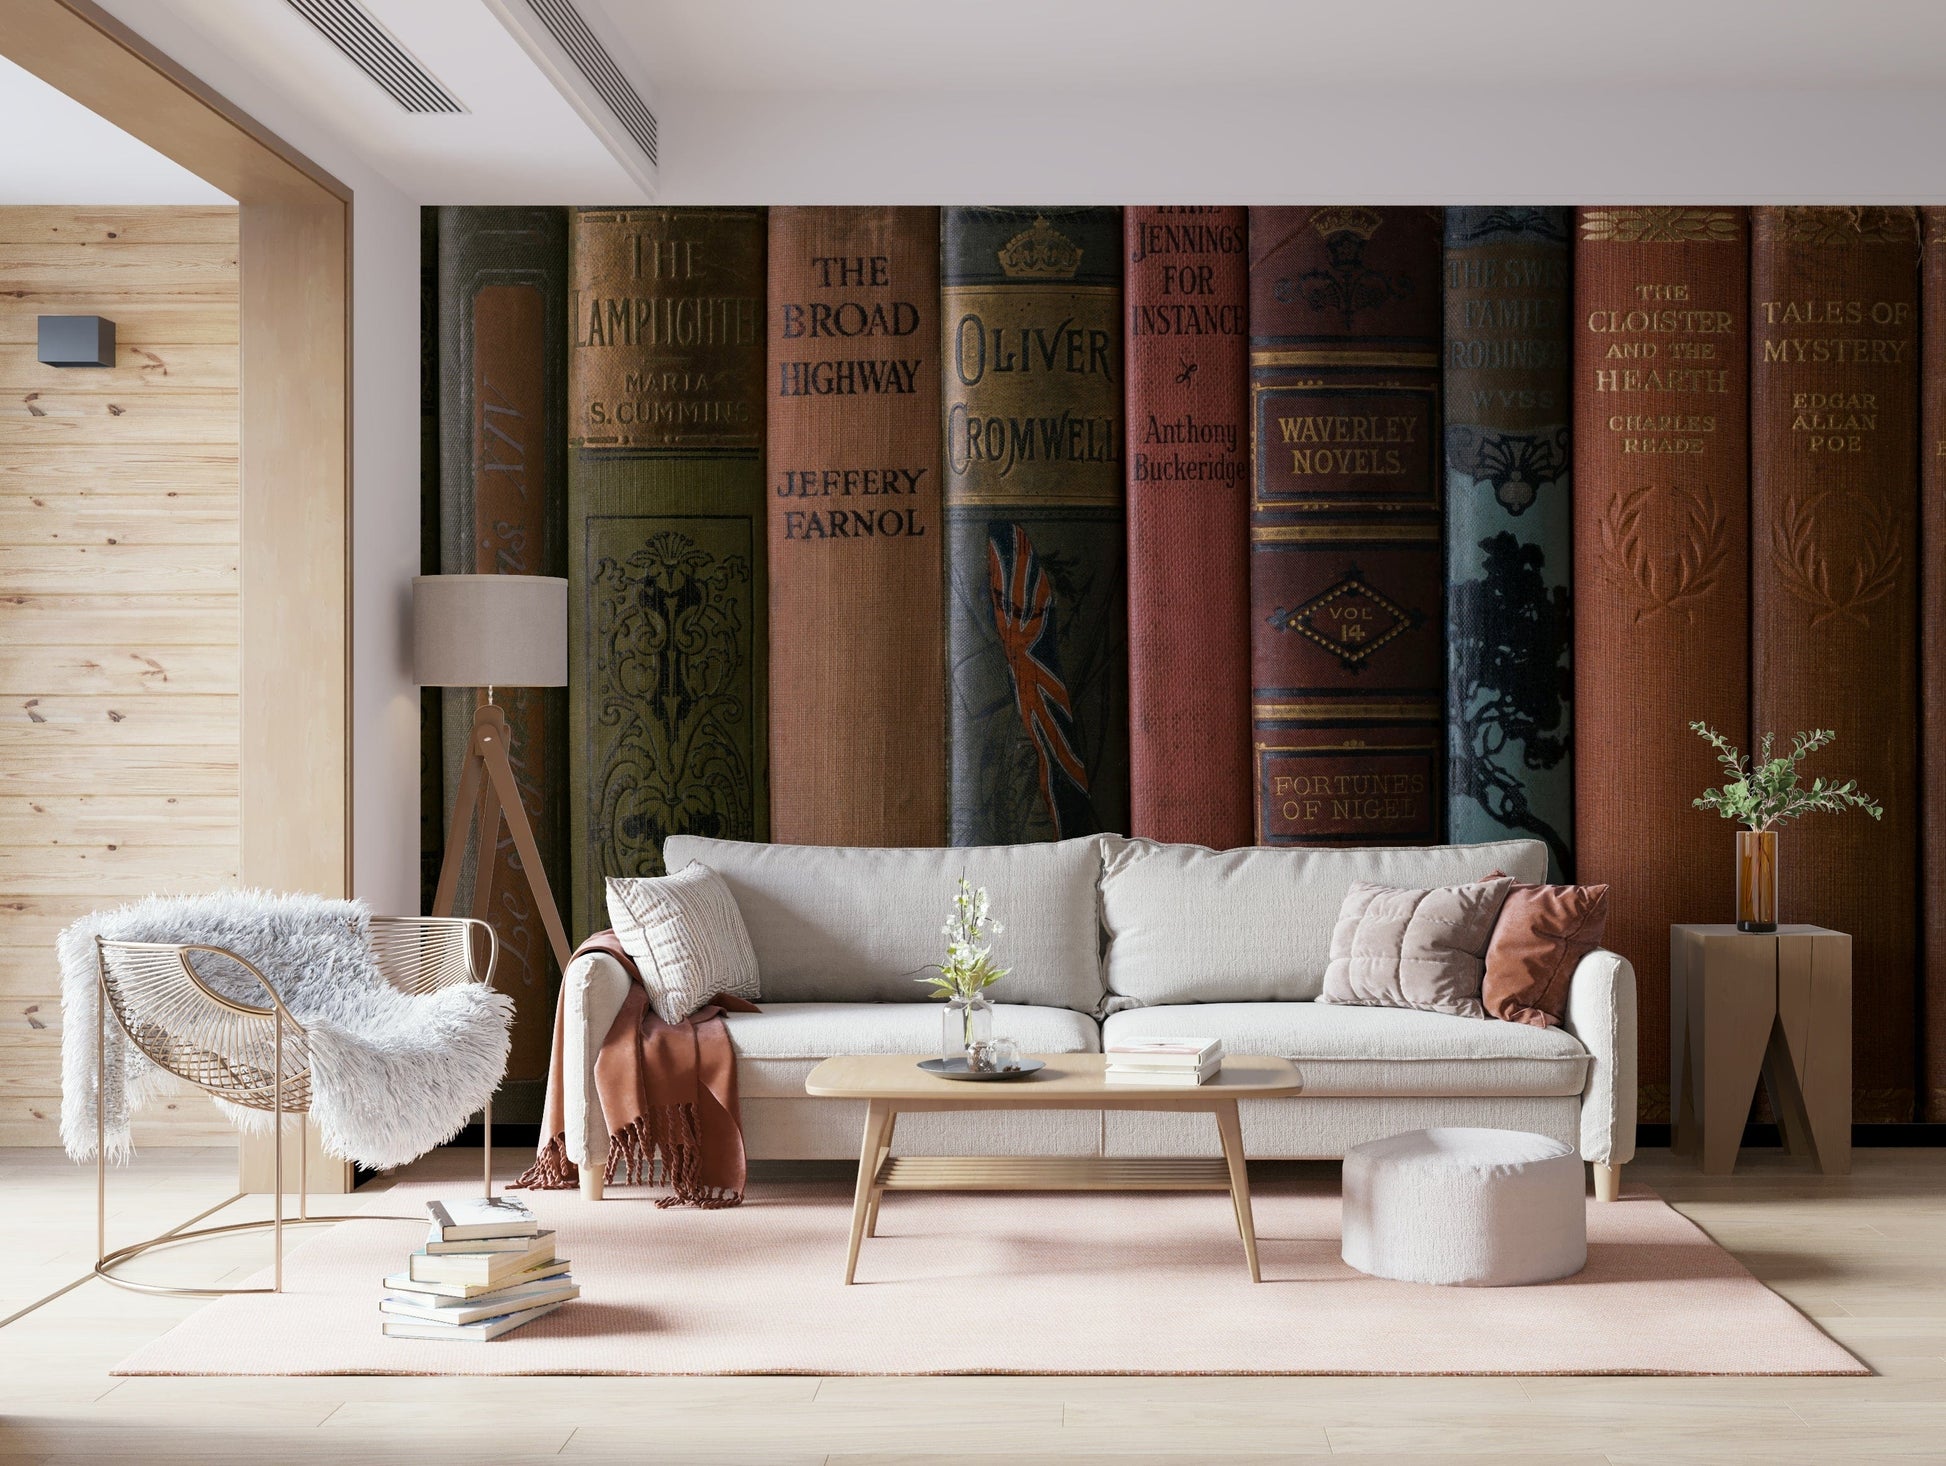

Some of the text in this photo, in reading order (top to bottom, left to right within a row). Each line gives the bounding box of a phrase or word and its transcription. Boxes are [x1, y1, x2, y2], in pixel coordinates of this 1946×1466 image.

[1132, 222, 1244, 263] JENNINGS
[624, 233, 705, 280] THE
[812, 256, 889, 287] THE
[1162, 265, 1215, 295] FOR
[1635, 284, 1689, 301] THE
[782, 302, 920, 338] BROAD
[1132, 304, 1245, 336] INSTANCE
[1588, 310, 1734, 333] CLOISTER
[1762, 302, 1910, 325] TALES OF
[955, 314, 1114, 386] OLIVER
[1605, 343, 1716, 359] AND THE
[1763, 339, 1907, 363] MYSTERY
[625, 372, 711, 394] MARIA
[779, 359, 922, 397] HIGHWAY
[1595, 369, 1729, 393] HEARTH
[1792, 393, 1878, 409] EDGAR
[1144, 415, 1238, 452] Anthony
[1278, 416, 1417, 443] WAVERLEY
[1609, 415, 1717, 432] CHARLES
[1791, 414, 1877, 430] ALLAN
[948, 402, 1120, 478] CROMWELL
[1809, 436, 1862, 452] POE
[1134, 453, 1246, 488] Buckeridge
[777, 468, 928, 498] JEFFERY
[784, 508, 925, 540] FARNOL
[1329, 607, 1373, 620] VOL
[1340, 624, 1366, 642] 14
[1274, 775, 1425, 796] FORTUNES
[1283, 799, 1416, 820] OF NIGEL
